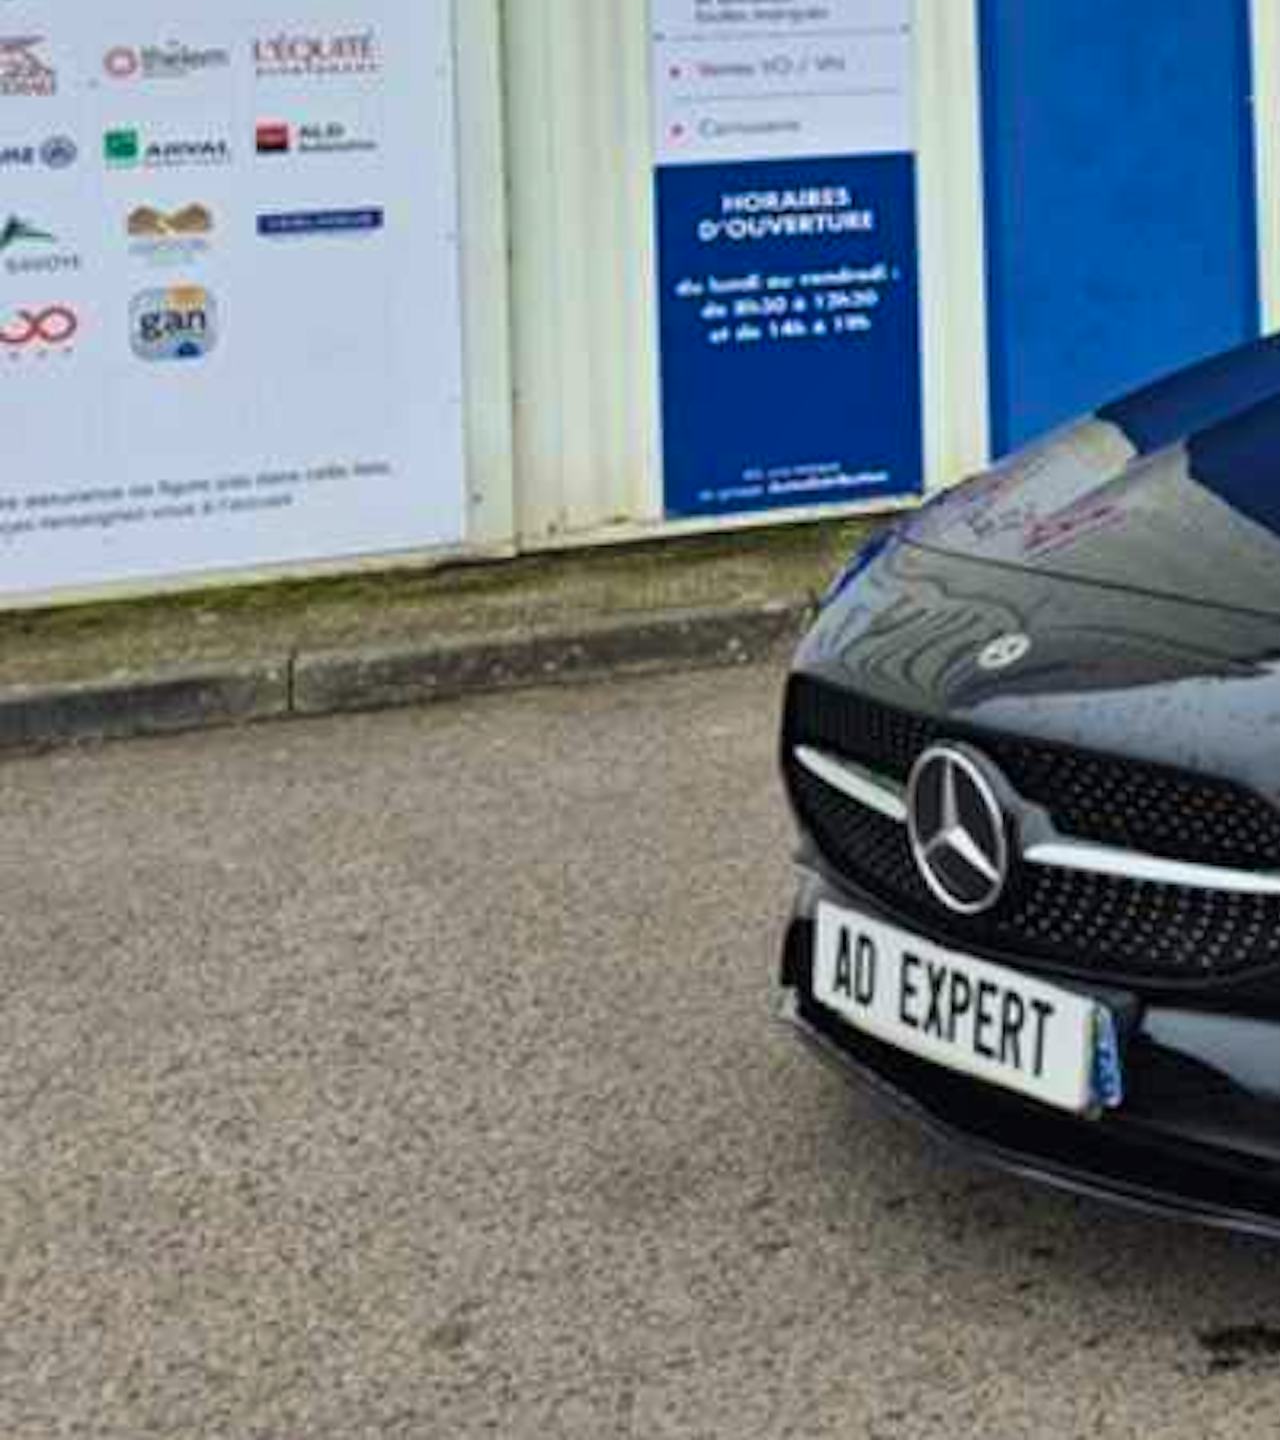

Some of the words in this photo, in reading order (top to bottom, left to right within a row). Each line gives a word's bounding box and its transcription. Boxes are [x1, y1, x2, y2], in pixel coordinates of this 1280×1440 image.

[720, 187, 851, 213] HORAIRES
[697, 210, 874, 242] D'OUVERTURE
[139, 309, 207, 342] gan
[831, 925, 877, 1007] AD
[899, 952, 1056, 1079] EXPERT
